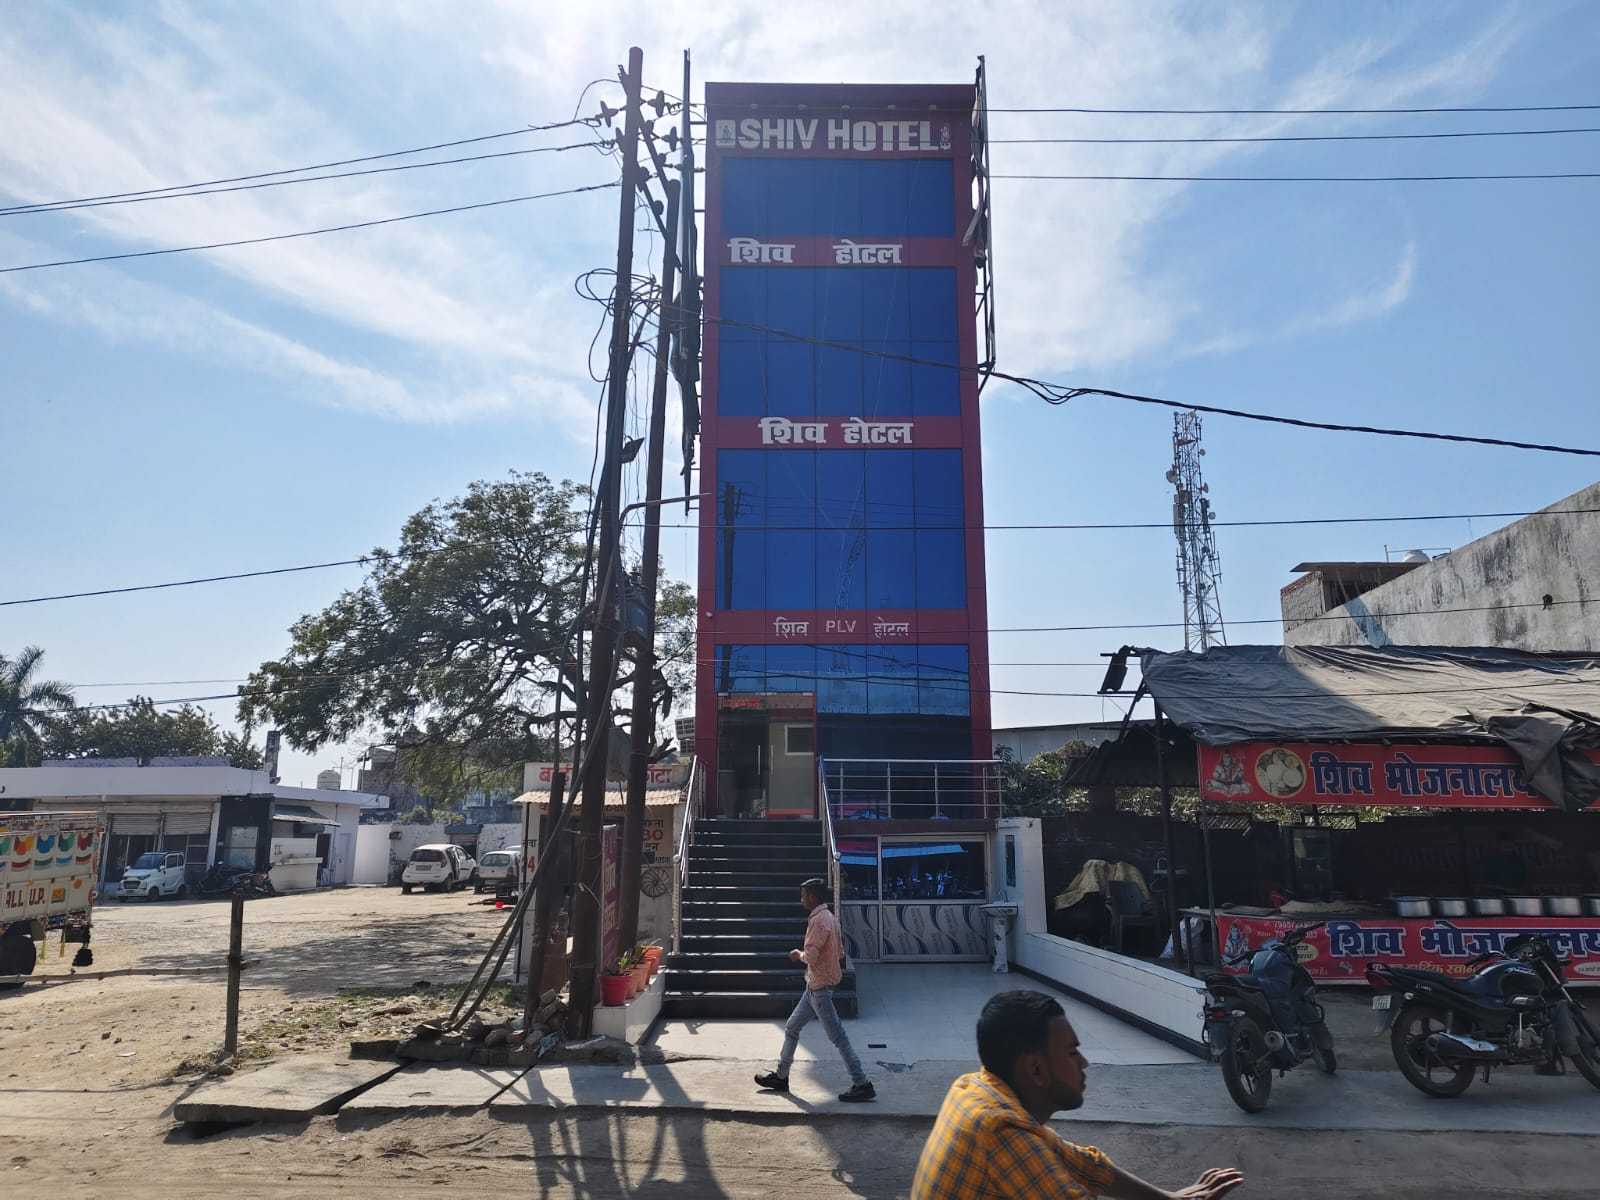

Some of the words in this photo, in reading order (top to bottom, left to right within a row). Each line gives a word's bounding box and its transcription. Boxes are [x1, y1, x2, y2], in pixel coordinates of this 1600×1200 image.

[739, 118, 819, 150] SHIV
[828, 118, 939, 151] HOTEL
[727, 237, 796, 263] शिव
[832, 239, 903, 264] होटल
[758, 417, 829, 444] शिव
[841, 417, 914, 445] होटल
[774, 617, 810, 639] शिव
[826, 620, 857, 633] PLV
[873, 616, 911, 639] होटल
[1310, 751, 1375, 796] शिव
[1325, 920, 1407, 958] शिव
[1420, 919, 1600, 958] भोजल
